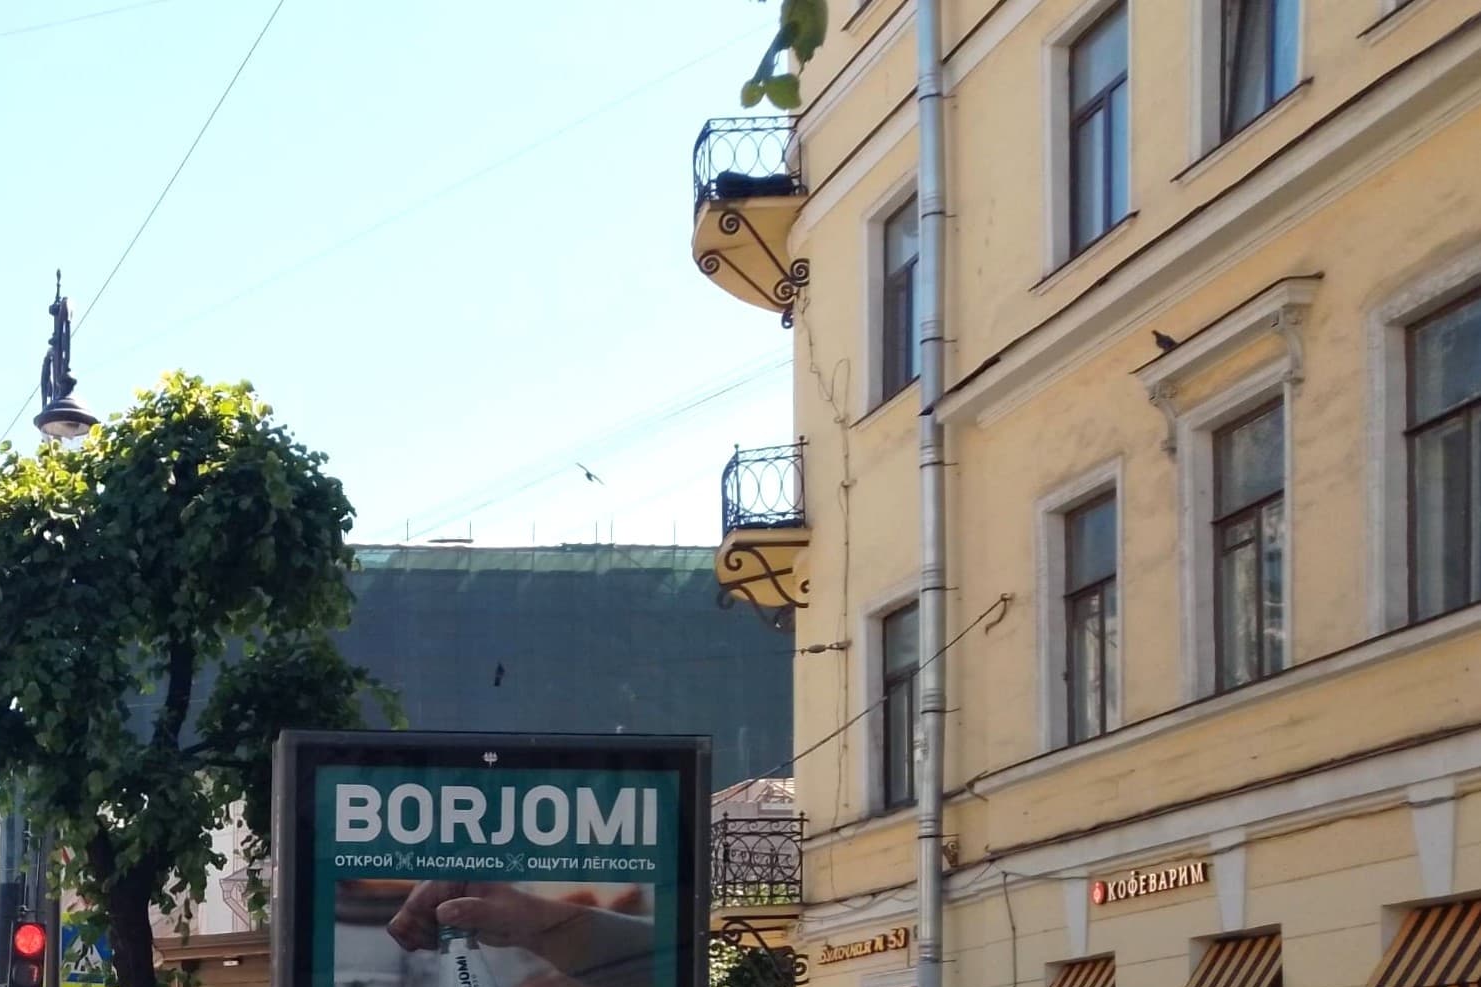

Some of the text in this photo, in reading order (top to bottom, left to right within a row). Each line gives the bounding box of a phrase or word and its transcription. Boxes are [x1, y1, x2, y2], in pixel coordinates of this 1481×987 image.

[335, 783, 658, 846] BORJOMI
[335, 854, 656, 871] ОТКРОЙ НАСЛАДИСЬ ОЩУТИ ЛЁГКОСТЬ
[1107, 862, 1205, 902] КОФЕВАРИМ
